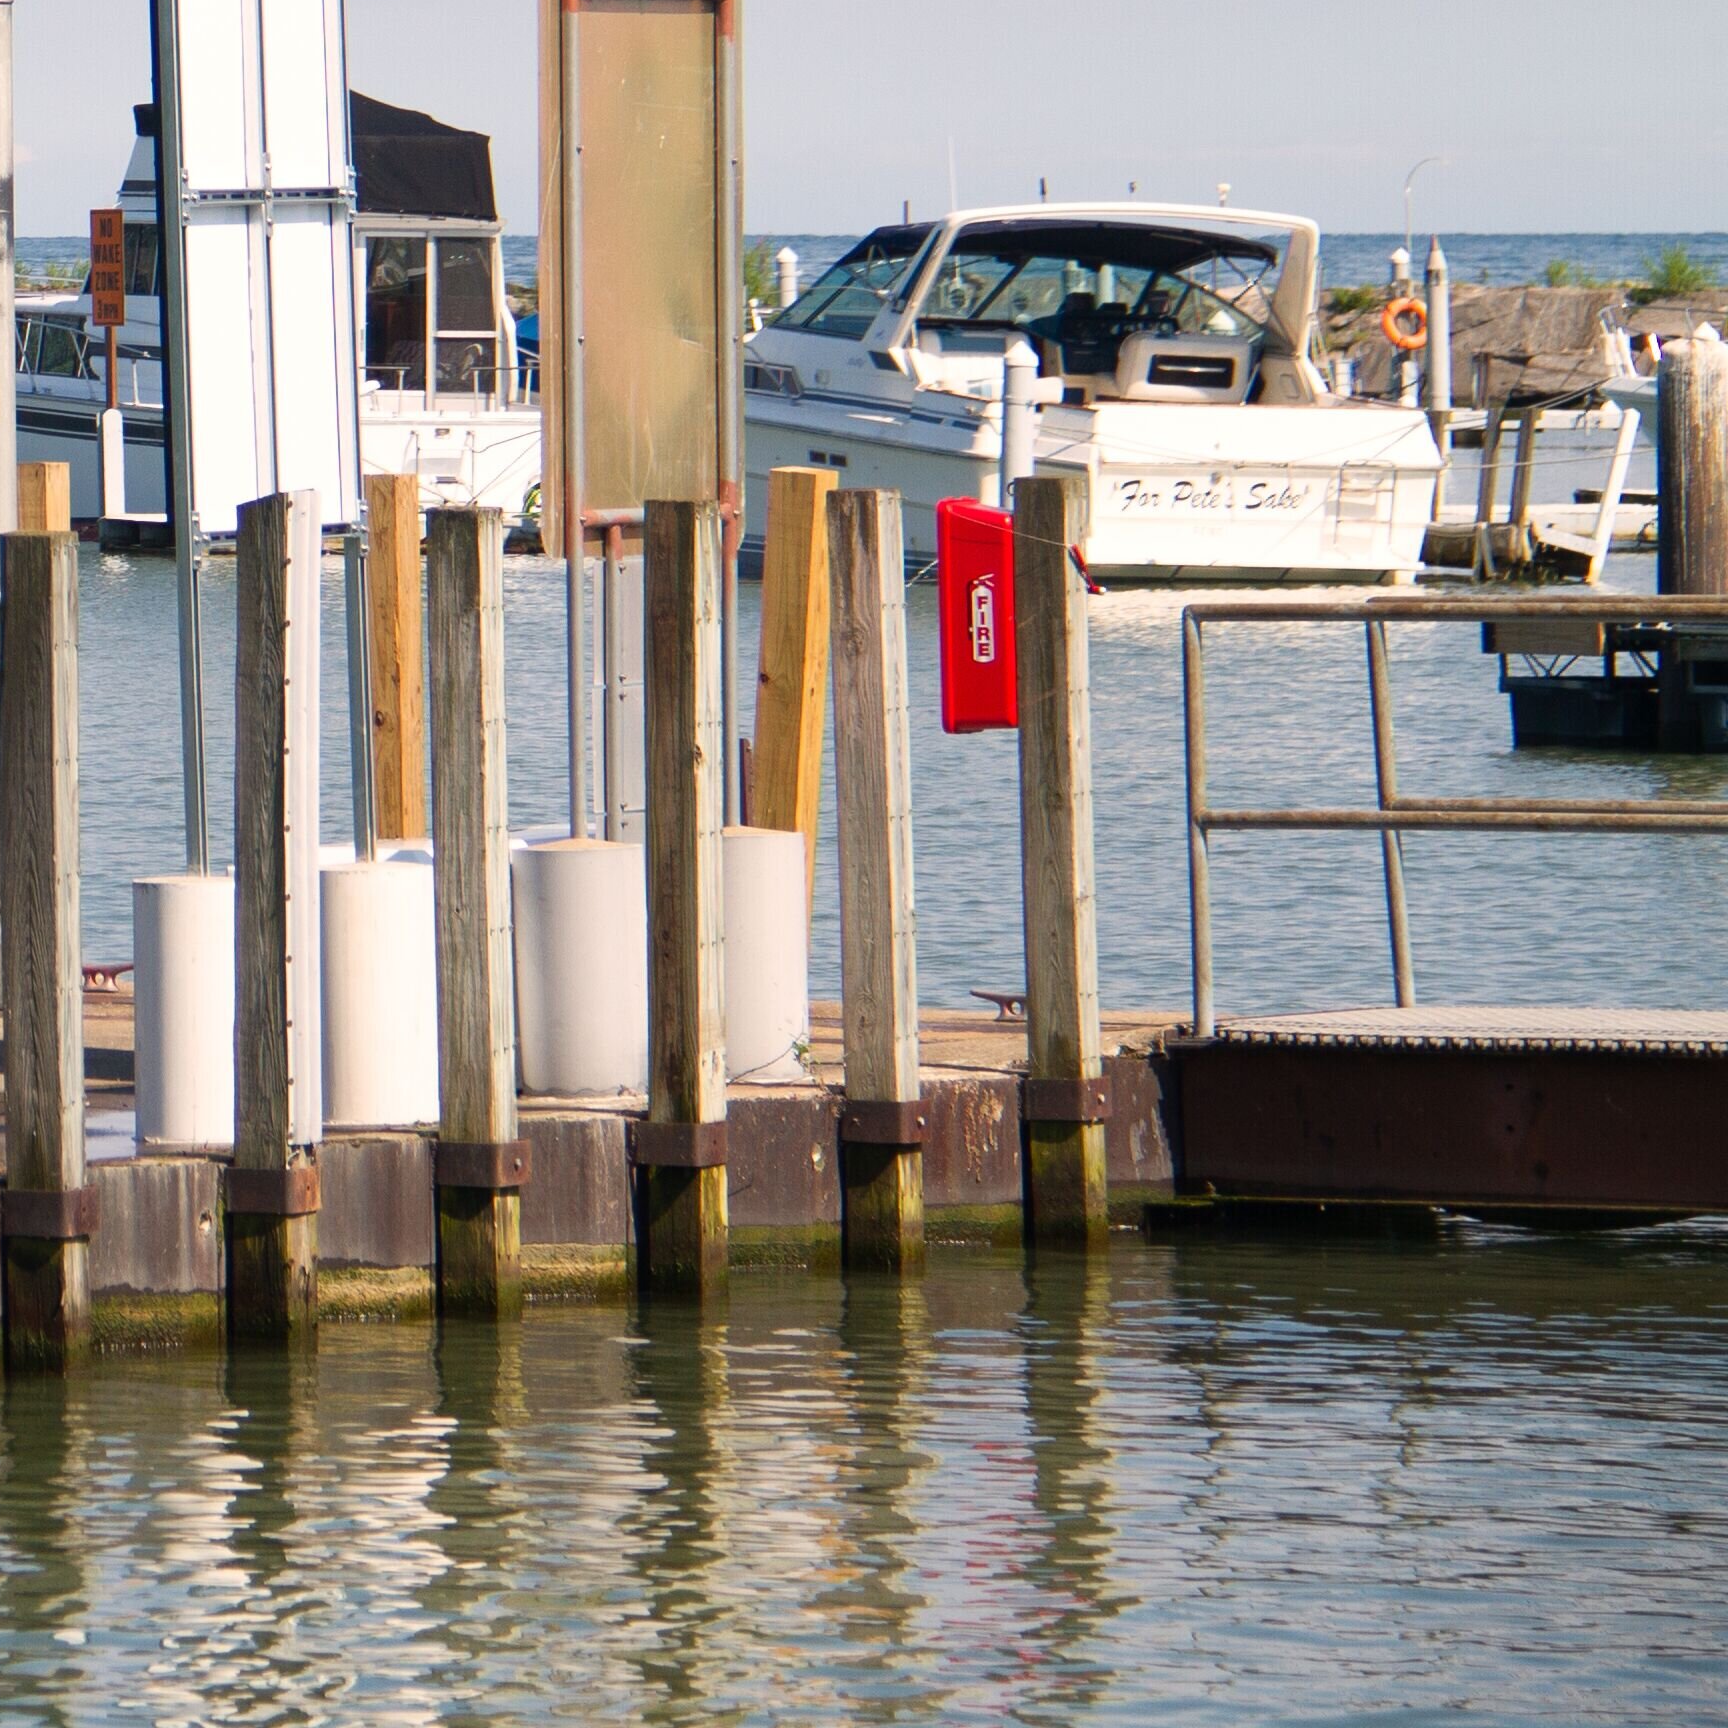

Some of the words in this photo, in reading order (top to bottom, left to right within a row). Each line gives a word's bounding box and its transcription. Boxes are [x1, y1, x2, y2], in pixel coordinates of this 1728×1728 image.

[100, 218, 112, 238] NO
[94, 244, 121, 264] WAKE
[96, 272, 120, 291] ZONE
[976, 596, 990, 656] FIRE
